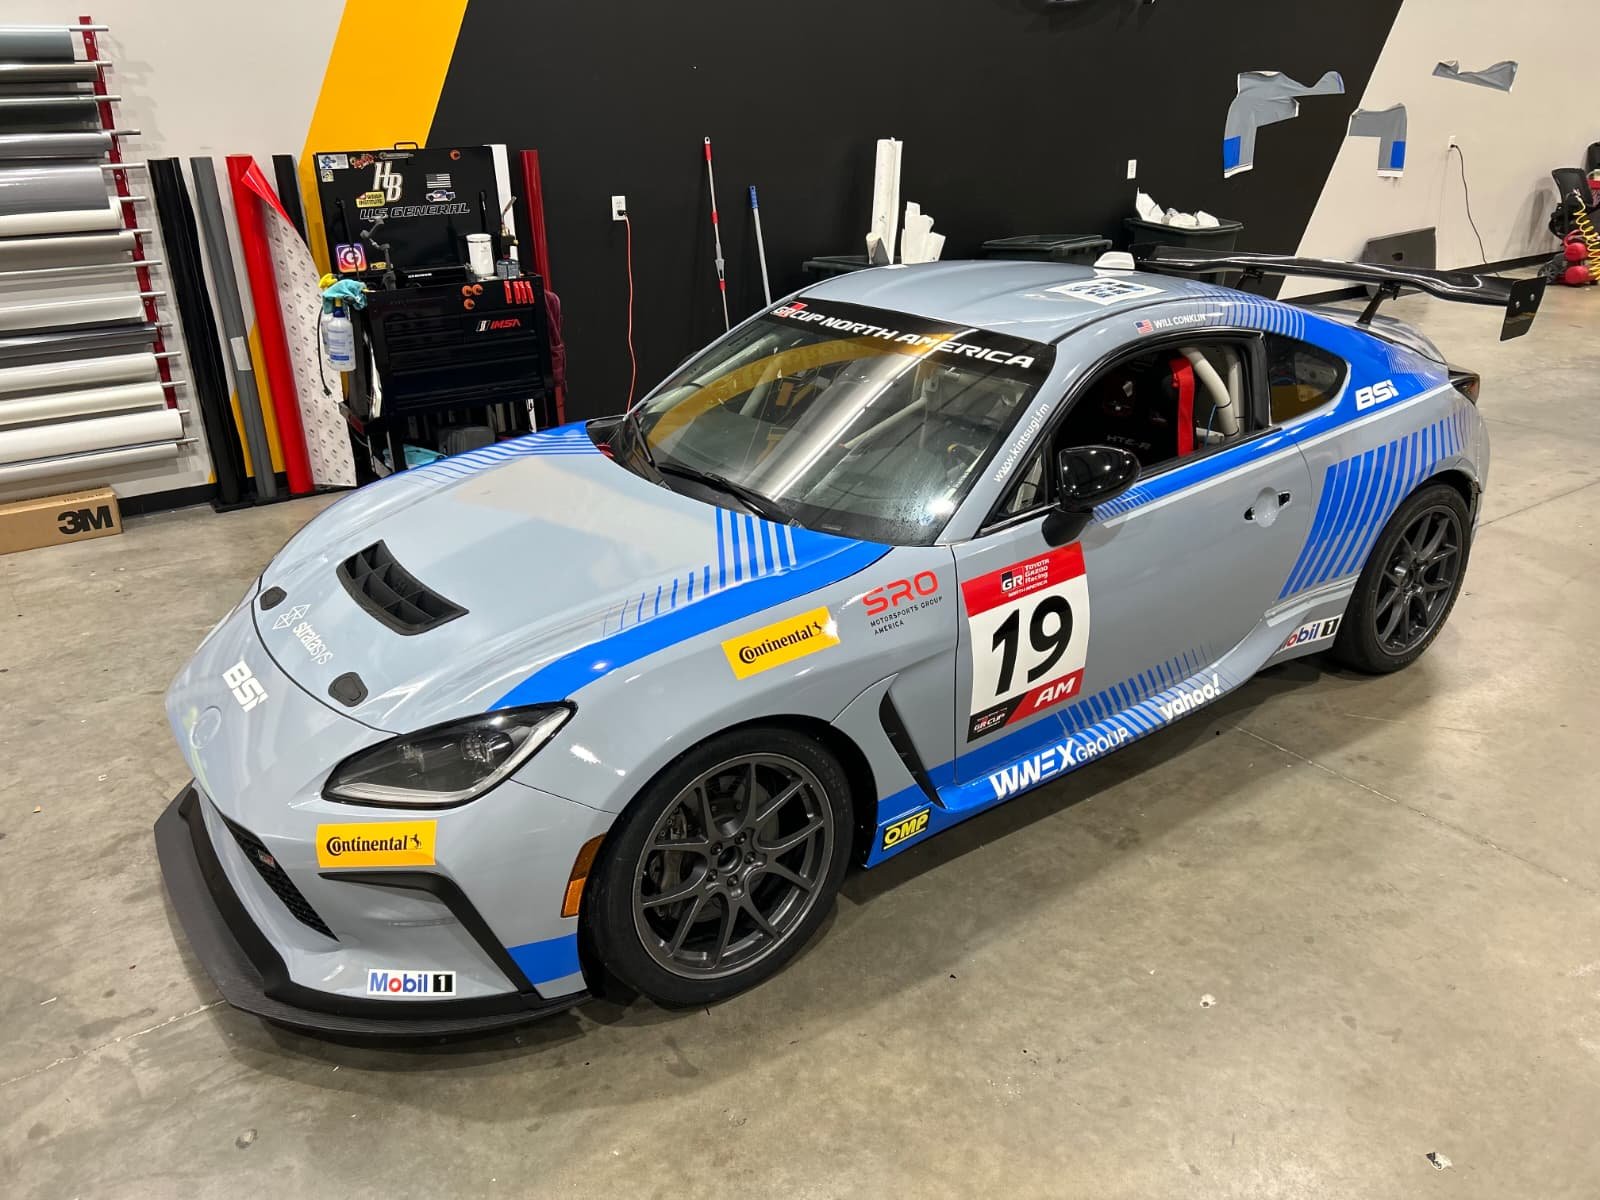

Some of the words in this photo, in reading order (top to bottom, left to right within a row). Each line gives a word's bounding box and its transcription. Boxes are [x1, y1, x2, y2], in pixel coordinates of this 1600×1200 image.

[372, 161, 403, 202] HB
[391, 203, 470, 218] GENERAL
[491, 319, 521, 329] IMSA
[1153, 317, 1174, 329] WILL
[1173, 313, 1206, 325] CONKLIN
[818, 317, 899, 340] NORTH
[900, 332, 1035, 369] AMERICA
[993, 402, 1050, 482] www.kintsugi.fm
[57, 505, 114, 535] 3M
[1025, 558, 1050, 571] TOYOTA
[863, 570, 939, 616] SRO
[1002, 574, 1023, 592] GR
[870, 604, 919, 628] MOTORSPORTS
[920, 595, 943, 609] GROUP
[874, 619, 905, 635] AMERICA
[292, 621, 334, 665] stratasys
[738, 624, 813, 665] Continental
[992, 595, 1074, 697] 19
[1280, 622, 1321, 649] obil
[1034, 676, 1076, 708] AM
[1159, 673, 1221, 720] yahoo!
[1075, 726, 1128, 763] GROUP
[884, 814, 929, 845] OMP
[326, 835, 408, 856] Continental
[370, 972, 428, 993] Mobil
